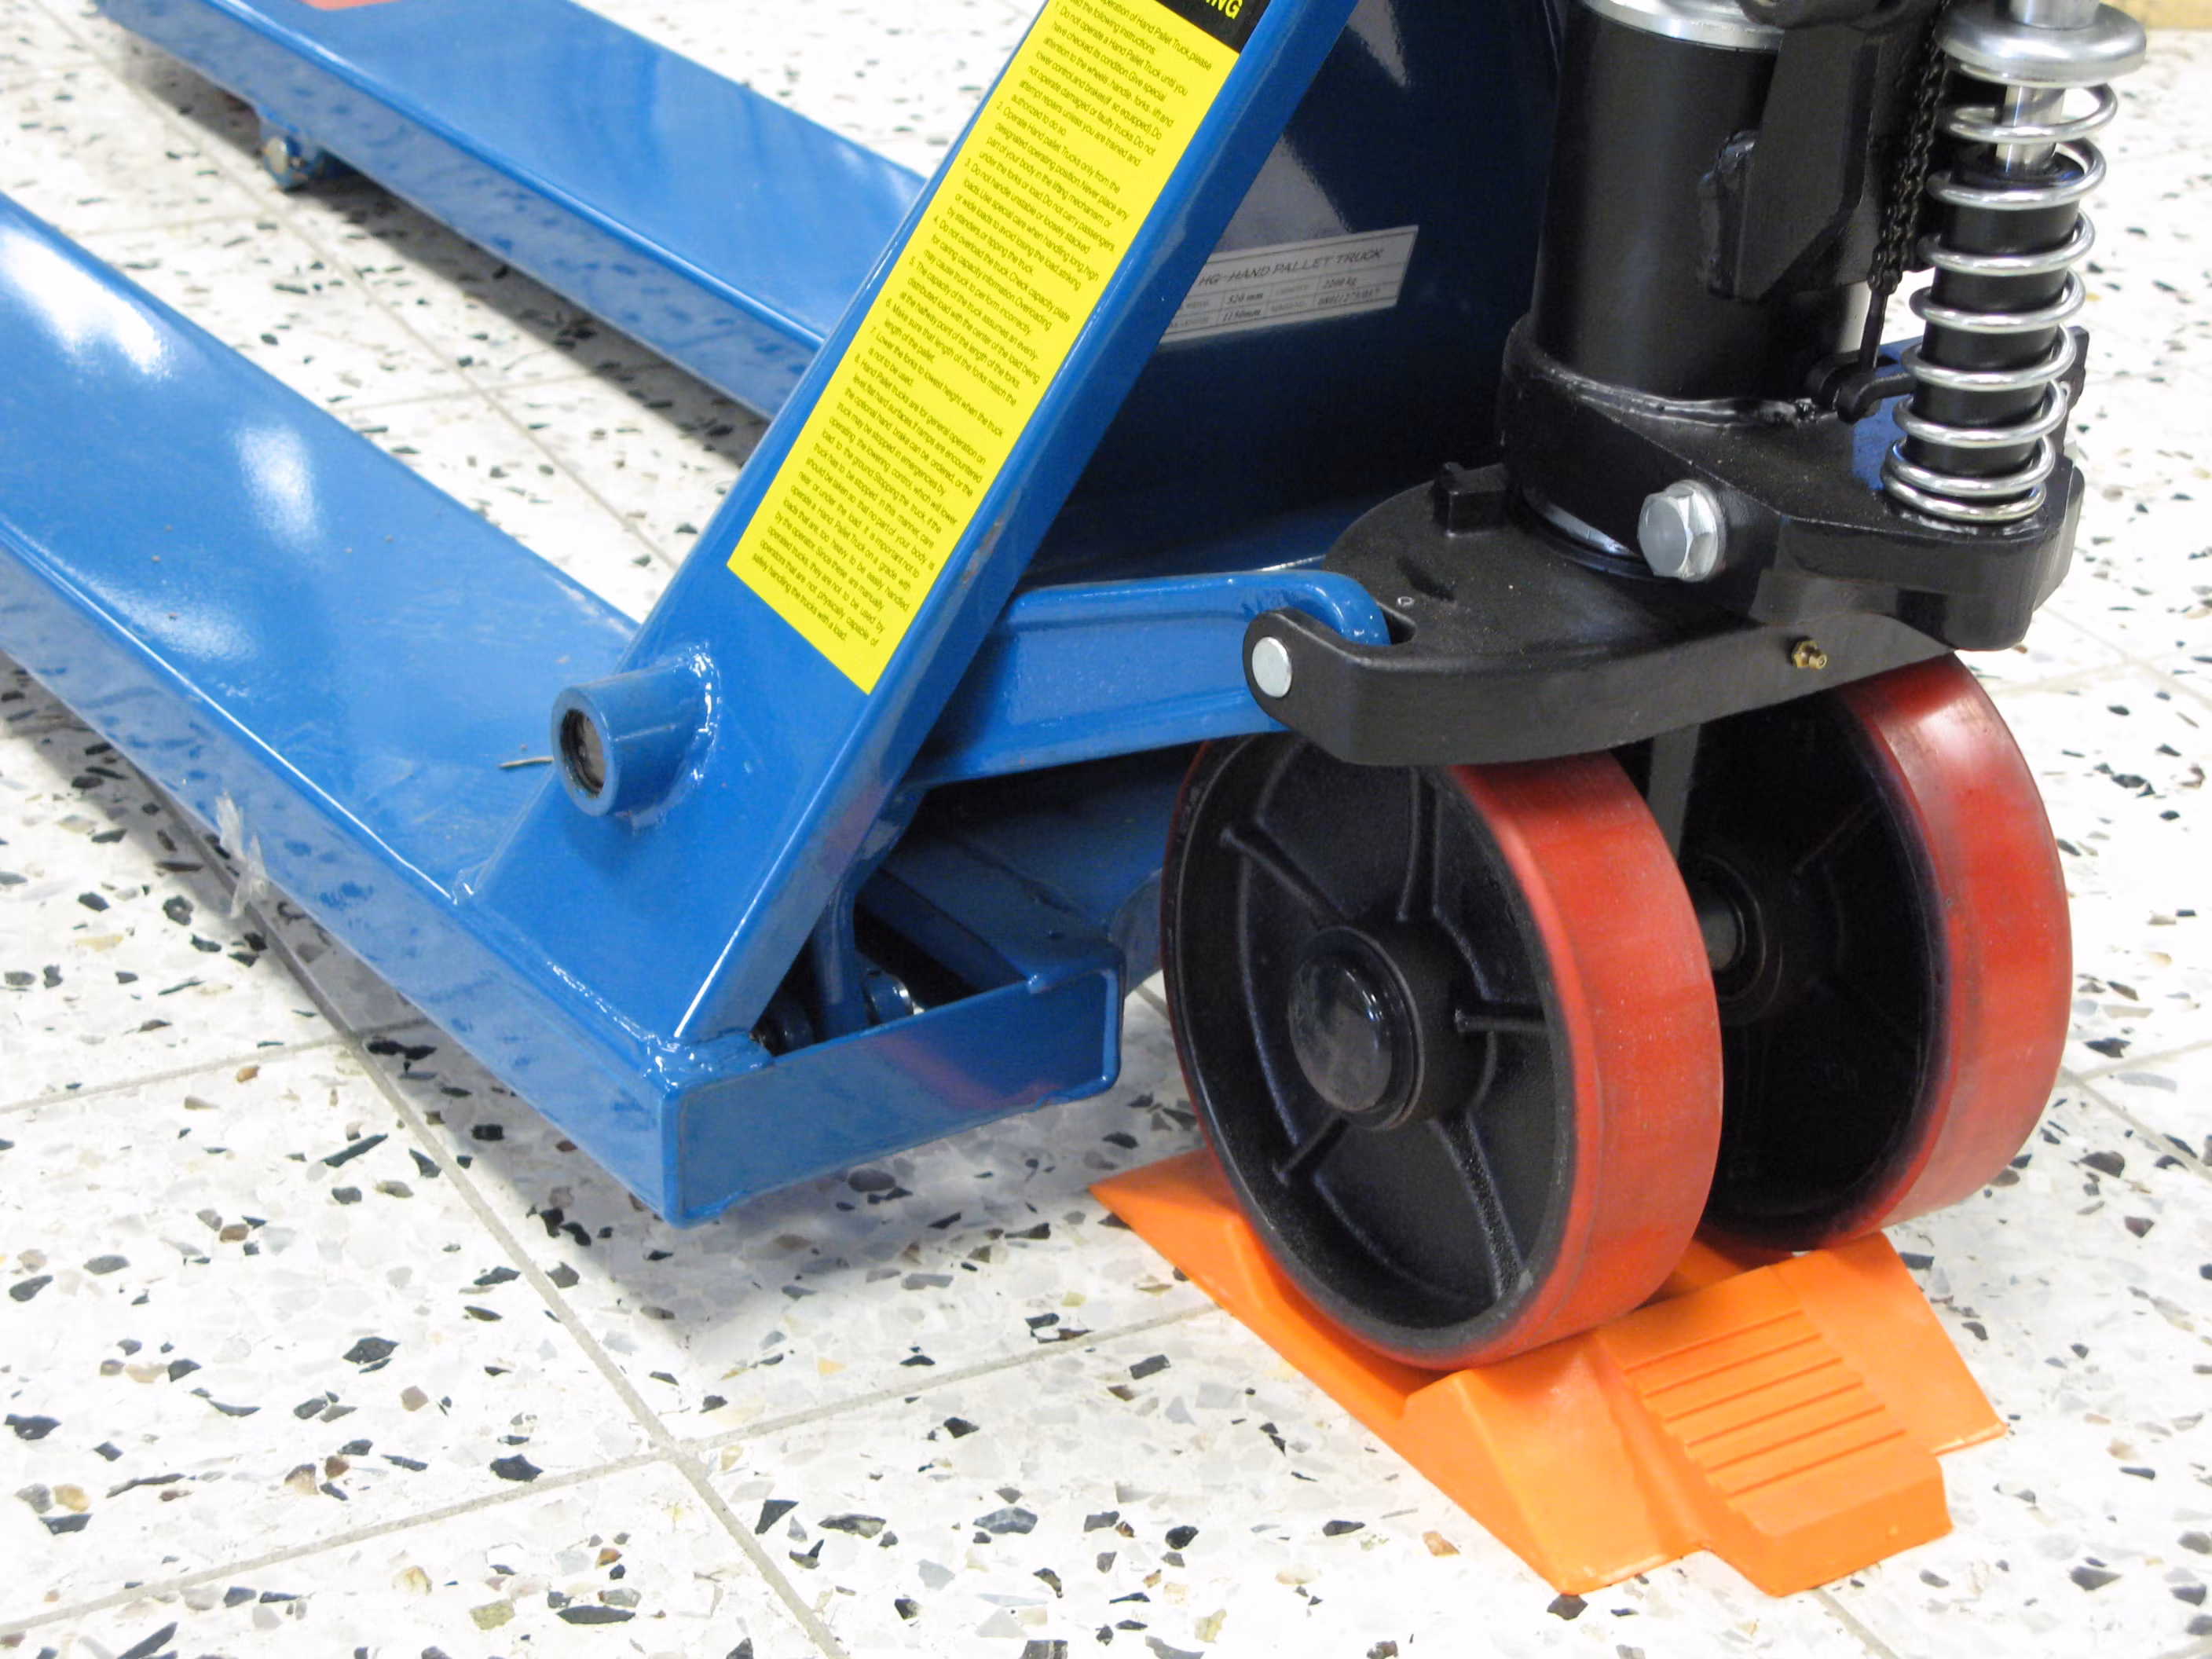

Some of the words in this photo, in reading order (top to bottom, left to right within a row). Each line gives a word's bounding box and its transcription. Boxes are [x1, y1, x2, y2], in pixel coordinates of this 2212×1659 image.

[1060, 5, 1070, 18] Do
[1069, 13, 1081, 26] not
[1079, 21, 1104, 41] operate
[1108, 38, 1127, 56] Hand
[1125, 49, 1144, 68] Pallet
[1144, 60, 1161, 79] Truck
[1160, 75, 1177, 88] until
[1173, 83, 1188, 96] you
[1003, 106, 1027, 129] Operate
[1027, 123, 1045, 141] Hand
[1061, 145, 1081, 167] Trucks
[1080, 162, 1095, 178] only
[1094, 170, 1109, 186] from
[1108, 181, 1120, 194] the
[1011, 94, 1043, 119] authorized
[1042, 113, 1049, 124] to
[1048, 119, 1058, 130] do
[1019, 79, 1043, 99] attempt
[1041, 94, 1063, 113] repairs
[1062, 109, 1083, 127] unless
[1081, 123, 1095, 135] you
[1094, 131, 1106, 143] are
[1105, 137, 1129, 158] trained
[1126, 153, 1141, 167] and
[971, 163, 980, 175] Do
[980, 171, 991, 183] not
[990, 177, 1011, 197] handle
[1010, 193, 1036, 216] unstable
[1035, 211, 1044, 220] or
[1043, 215, 1065, 237] loosely
[1064, 233, 1090, 255] stacked
[986, 136, 1001, 149] part
[1005, 149, 1020, 163] your
[1019, 157, 1036, 176] body
[1035, 170, 1042, 179] in
[1041, 174, 1053, 187] the
[1068, 194, 1104, 223] mechanism
[1103, 219, 1112, 229] or
[916, 261, 928, 276] The
[926, 272, 951, 295] capacity
[950, 290, 959, 299] of
[957, 294, 968, 306] the
[966, 302, 982, 318] truck
[981, 314, 1009, 339] assumes
[1008, 334, 1017, 345] an
[1273, 256, 1331, 273] PALLET
[1335, 247, 1384, 265] TRUCK
[892, 303, 909, 322] Make
[907, 318, 922, 333] sure
[921, 328, 936, 342] that
[934, 336, 954, 357] length
[953, 353, 962, 363] of
[961, 357, 972, 372] the
[972, 365, 987, 383] forks
[987, 379, 1006, 398] match
[1005, 393, 1016, 406] the
[899, 291, 907, 301] at
[905, 295, 916, 307] the
[915, 302, 938, 325] halfway
[936, 320, 953, 336] point
[951, 331, 961, 341] of
[958, 335, 969, 349] the
[968, 342, 987, 363] length
[987, 359, 996, 368] of
[993, 363, 1005, 376] the
[907, 277, 939, 304] distributed
[936, 298, 952, 314] load
[950, 309, 963, 324] with
[961, 318, 972, 331] the
[972, 327, 992, 344] center
[991, 342, 1000, 350] of
[998, 346, 1009, 358] the
[1008, 353, 1024, 369] load
[1021, 364, 1040, 385] being
[860, 359, 877, 377] Hand
[876, 372, 892, 390] Pallet
[891, 384, 910, 404] trucks
[908, 400, 919, 412] are
[918, 405, 928, 418] for
[925, 415, 950, 436] general
[949, 432, 977, 458] operation
[976, 455, 986, 465] on
